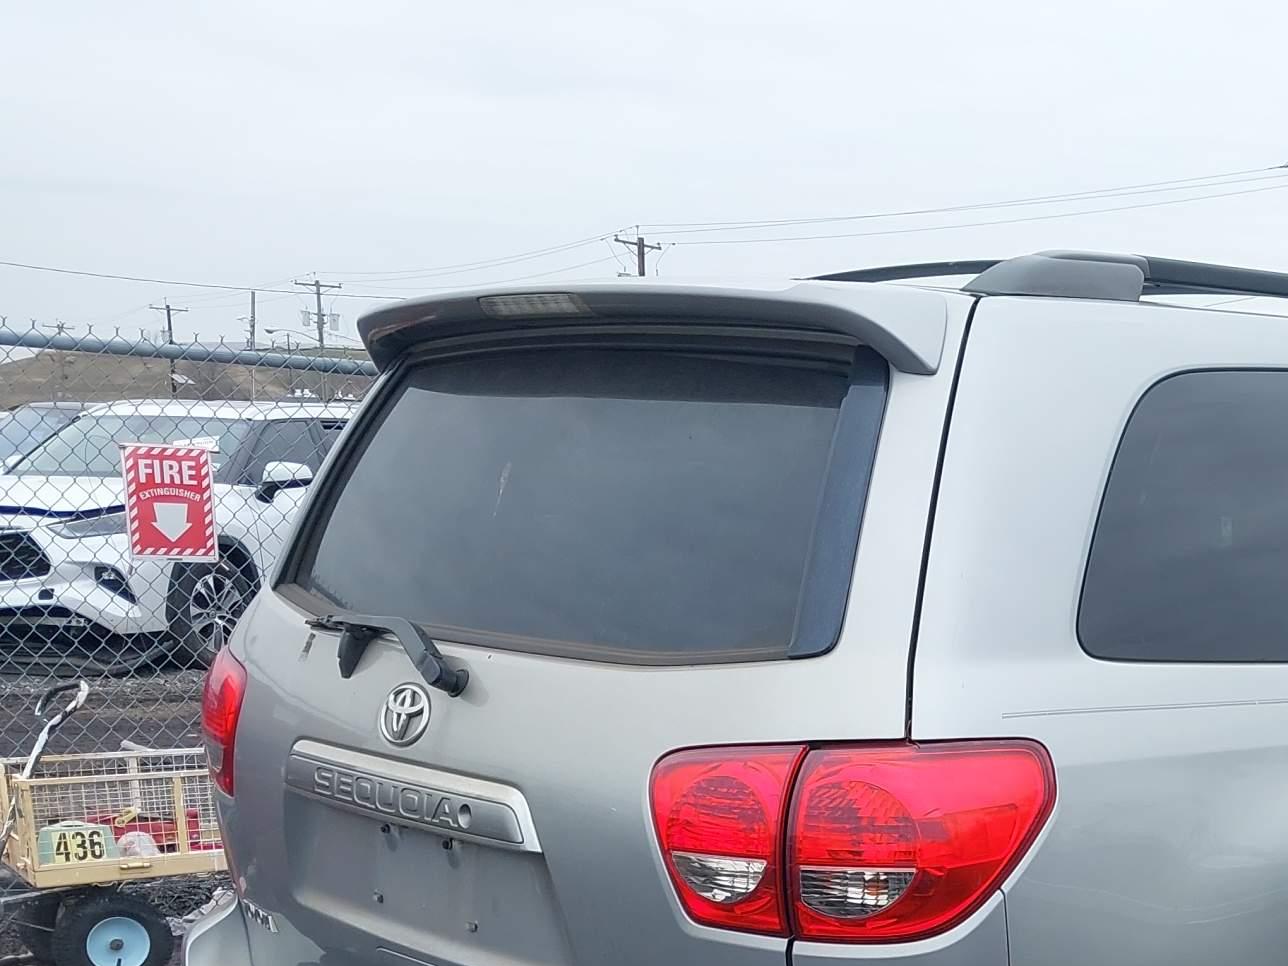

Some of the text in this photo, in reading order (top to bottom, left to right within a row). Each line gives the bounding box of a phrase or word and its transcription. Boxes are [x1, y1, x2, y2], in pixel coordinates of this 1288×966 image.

[138, 458, 199, 486] FIRE
[139, 487, 202, 502] EXTINGUISHER
[313, 766, 459, 828] SEQUOIA
[55, 830, 105, 862] 436
